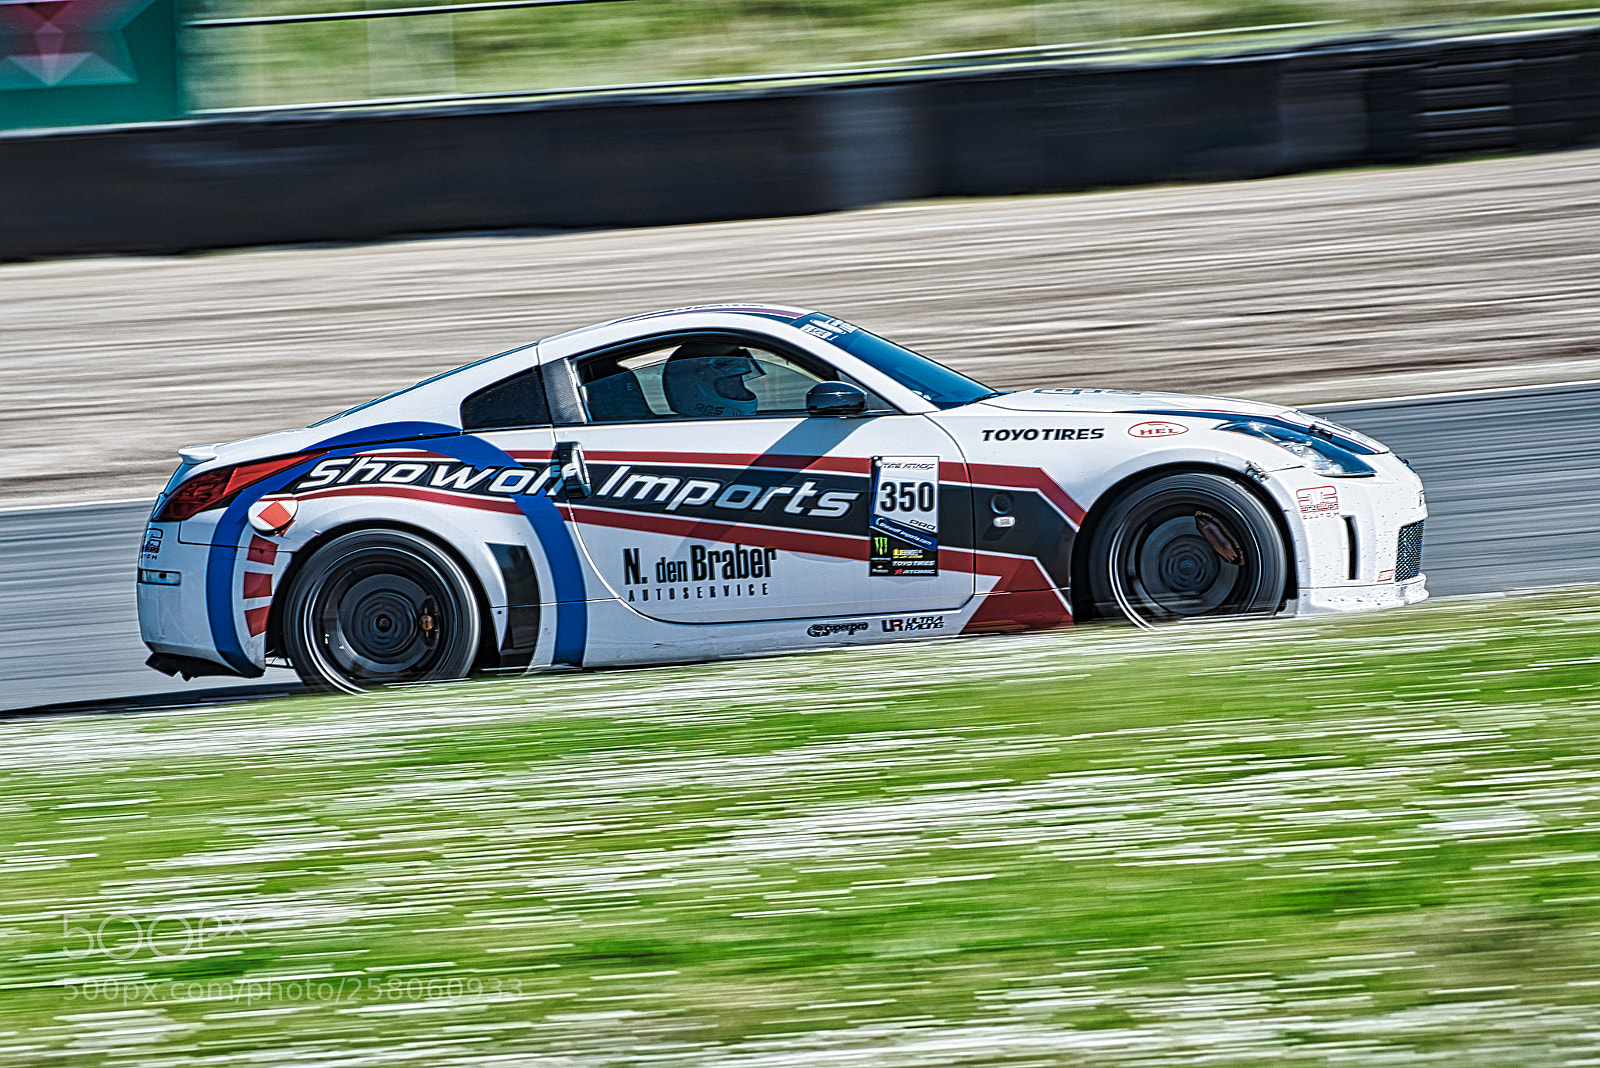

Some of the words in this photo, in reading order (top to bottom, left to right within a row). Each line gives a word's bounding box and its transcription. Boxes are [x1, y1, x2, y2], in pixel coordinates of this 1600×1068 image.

[981, 429, 1038, 442] TOYO
[1041, 428, 1105, 441] TIRES
[1140, 427, 1179, 437] HEL
[596, 465, 860, 517] Imports
[880, 482, 935, 512] 350
[623, 548, 648, 585] N.
[655, 557, 689, 583] den
[690, 543, 778, 581] Braber
[628, 583, 769, 602] AUTOSERVICE
